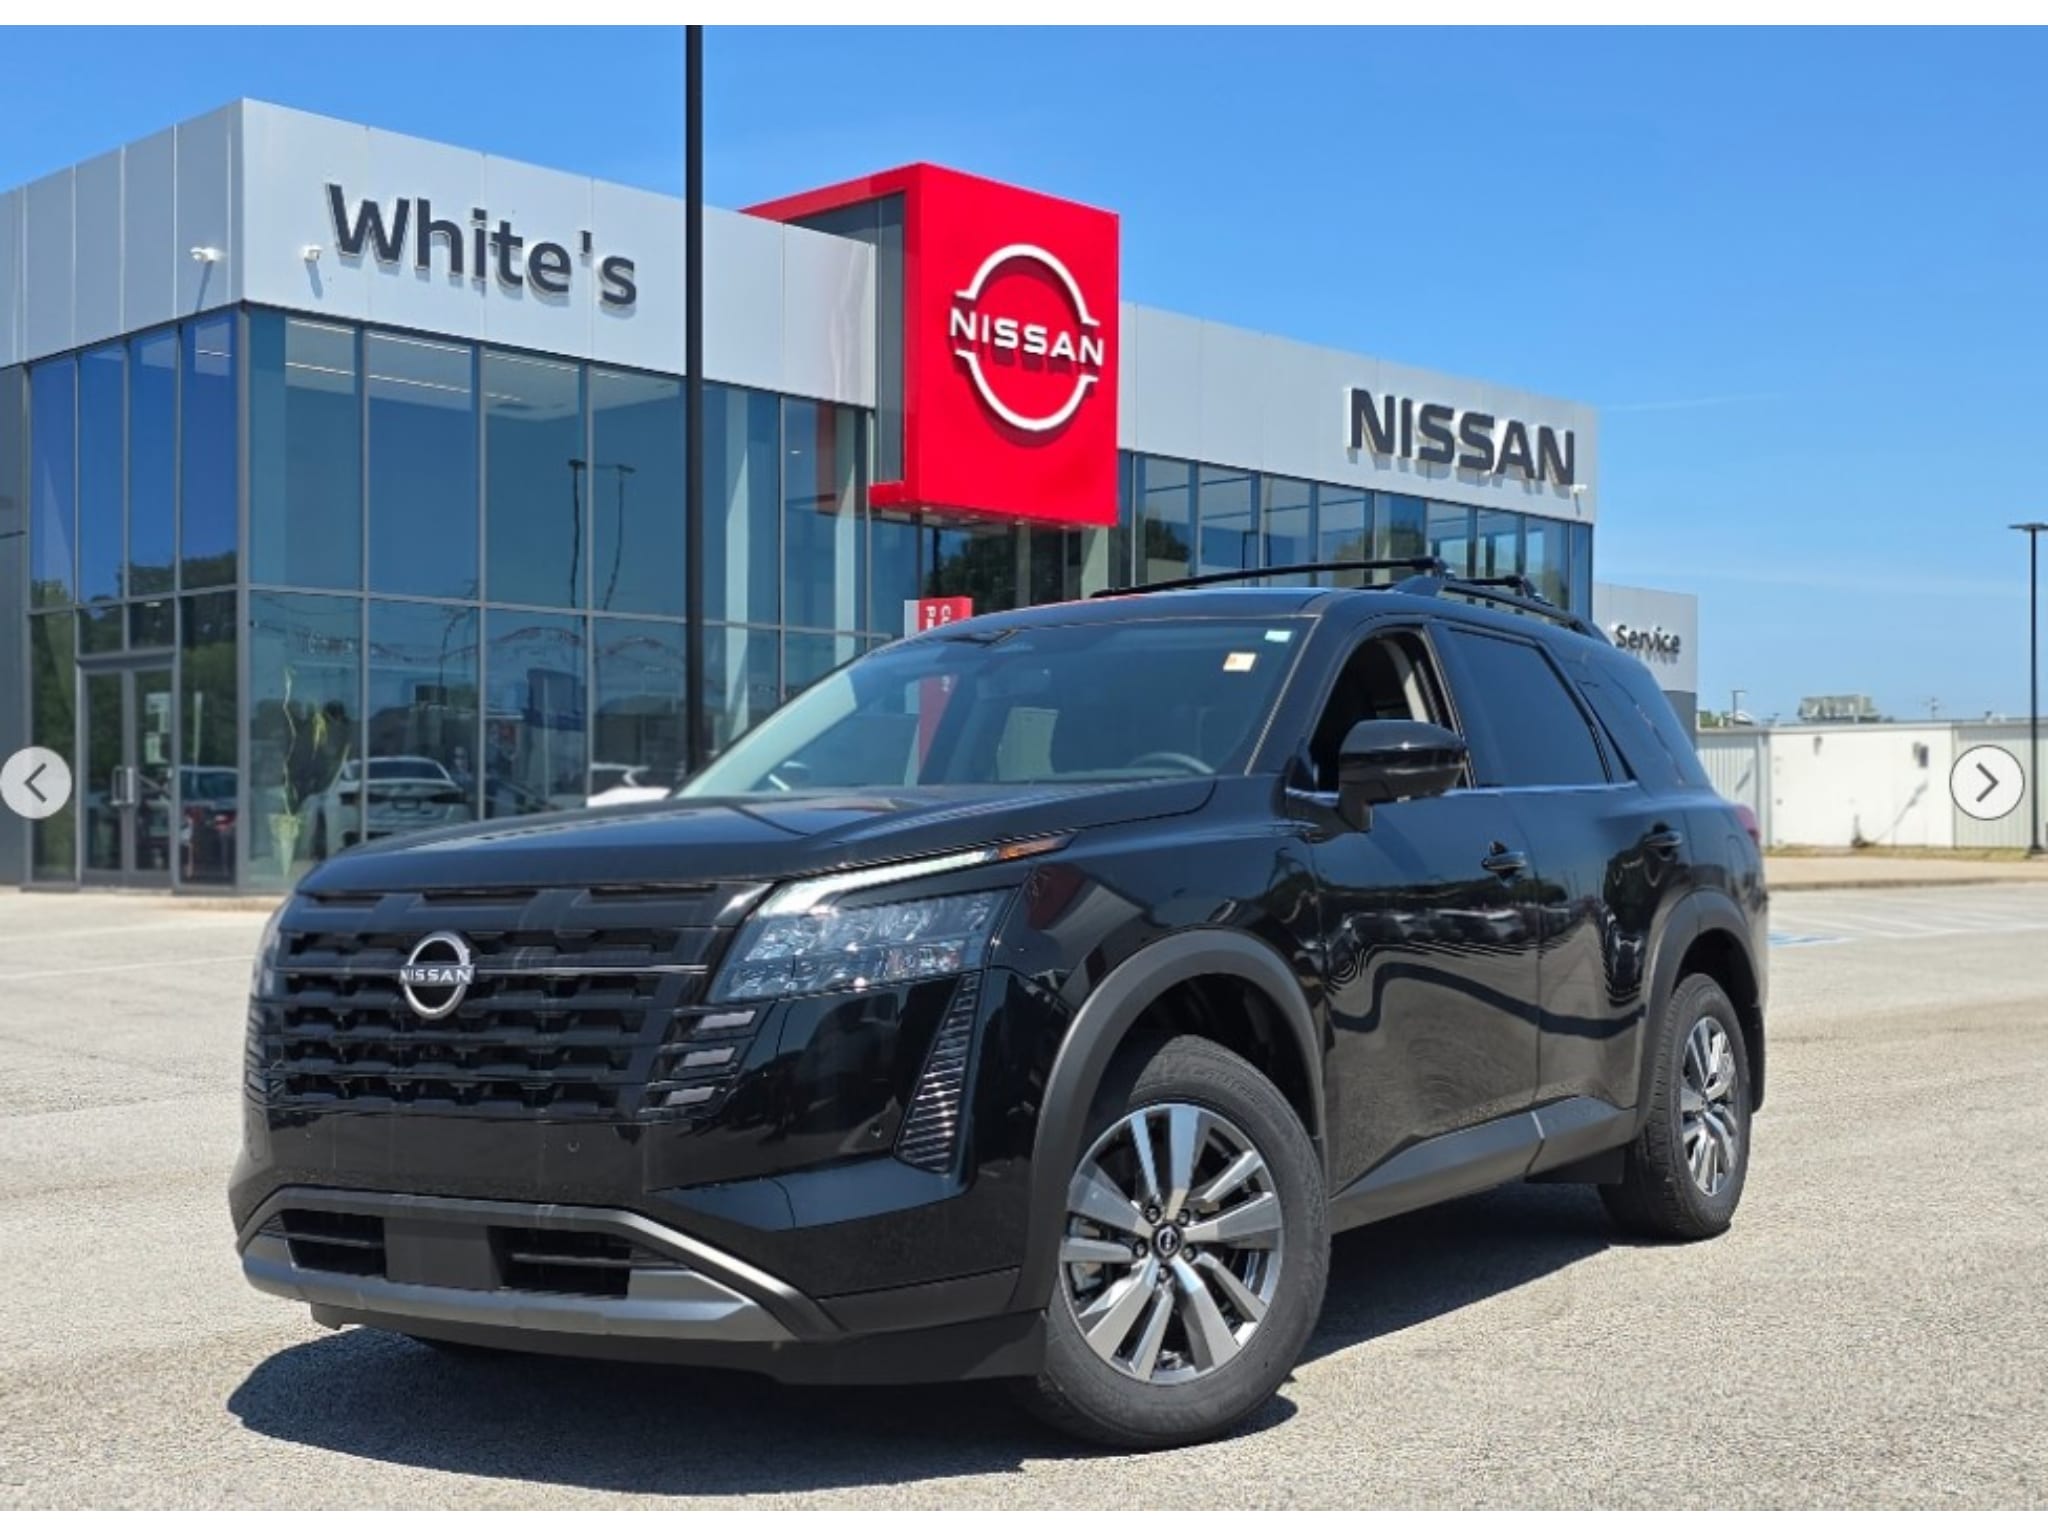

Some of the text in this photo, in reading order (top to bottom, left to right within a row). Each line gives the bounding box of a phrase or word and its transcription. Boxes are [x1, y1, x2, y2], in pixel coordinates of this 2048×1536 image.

[328, 183, 637, 306] White's
[949, 307, 1104, 366] NISSAN
[1350, 388, 1575, 486] NISSAN
[1615, 624, 1681, 654] Service
[399, 968, 473, 983] NISSAN
